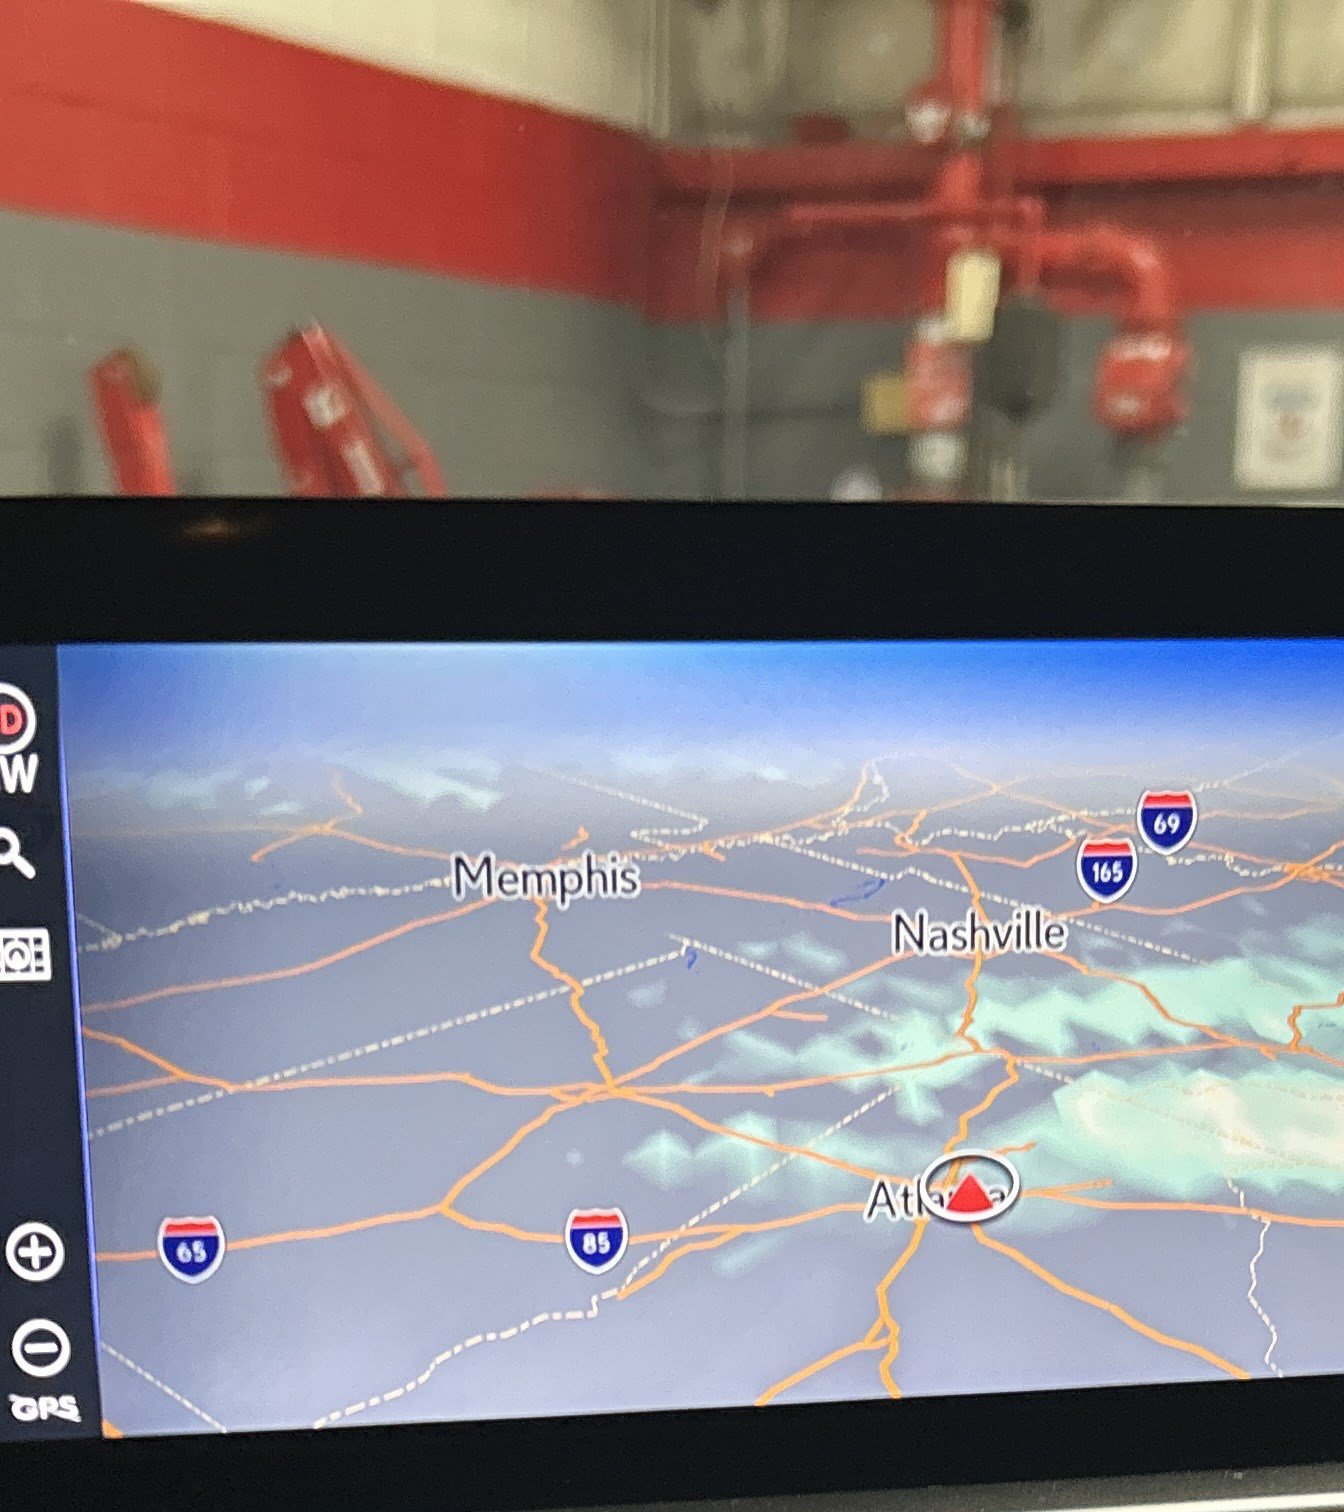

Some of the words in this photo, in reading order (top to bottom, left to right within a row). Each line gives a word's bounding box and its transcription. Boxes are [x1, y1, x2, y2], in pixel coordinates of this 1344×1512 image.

[1153, 812, 1180, 834] 69
[454, 855, 640, 908] Memphis
[1091, 862, 1124, 883] 165
[893, 910, 1068, 956] Nashville
[175, 1241, 207, 1266] 65
[581, 1231, 611, 1256] 85
[10, 1394, 80, 1423] GPS
